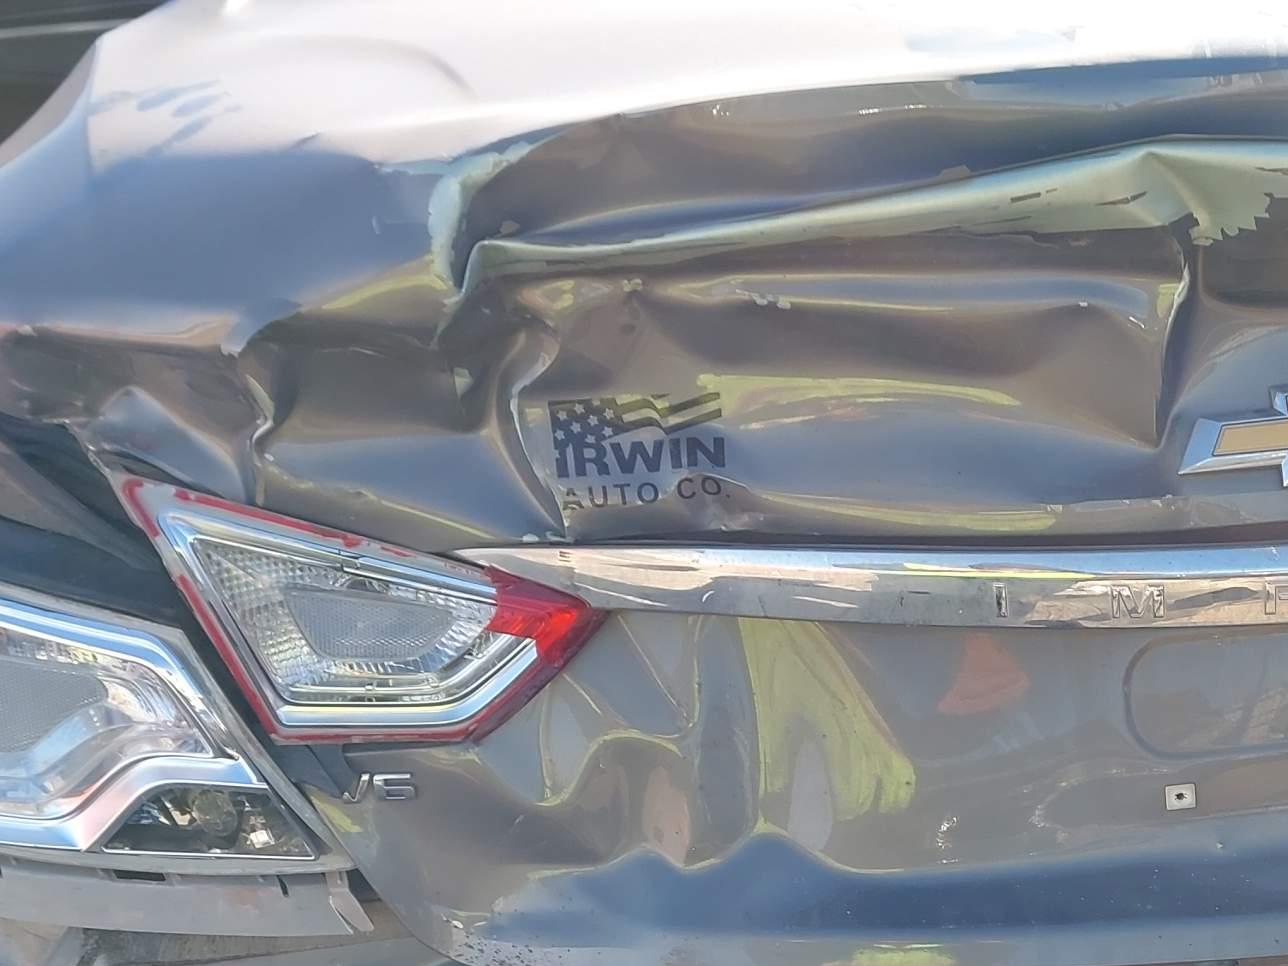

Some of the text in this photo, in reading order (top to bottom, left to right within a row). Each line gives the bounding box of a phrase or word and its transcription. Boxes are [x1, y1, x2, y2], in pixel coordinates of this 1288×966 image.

[555, 436, 727, 478] IRWIN
[562, 475, 731, 511] AUTO CO.
[342, 772, 416, 802] V6
